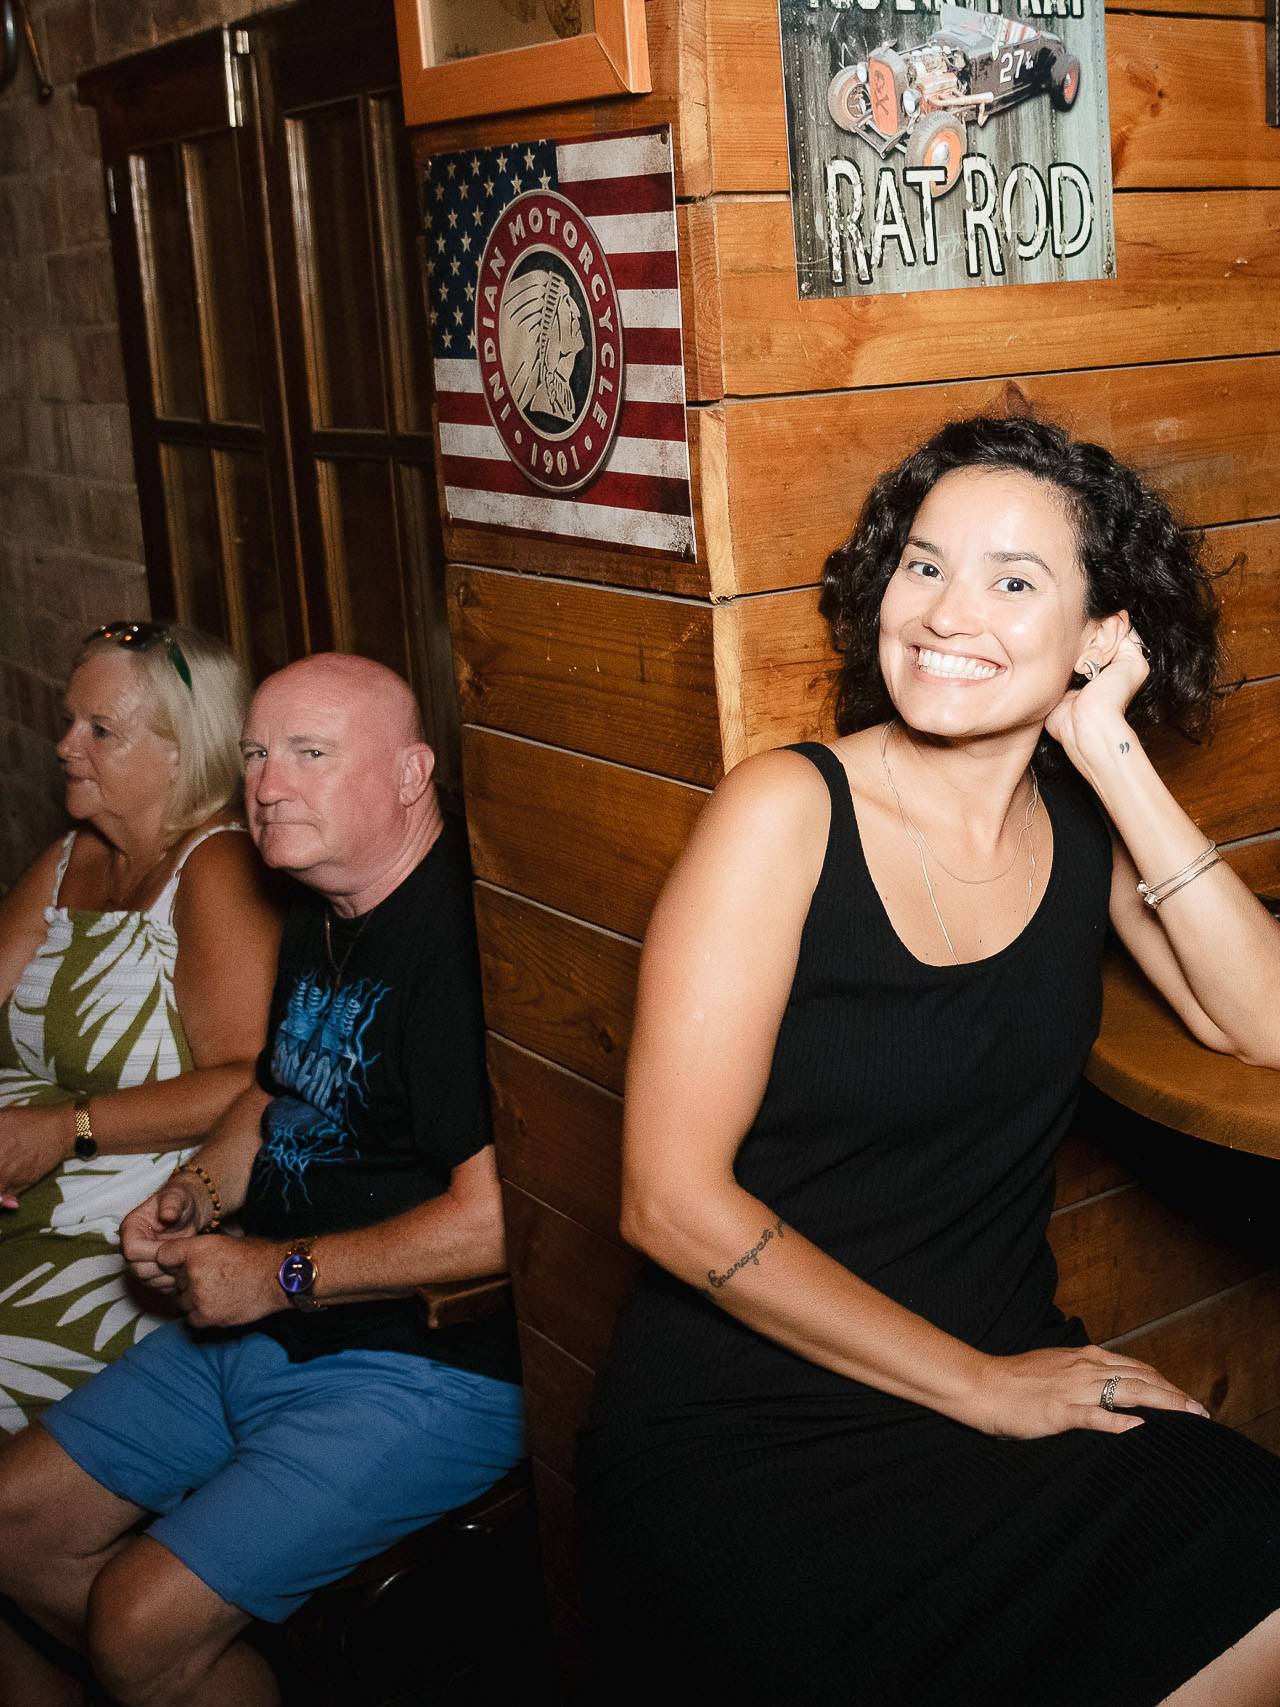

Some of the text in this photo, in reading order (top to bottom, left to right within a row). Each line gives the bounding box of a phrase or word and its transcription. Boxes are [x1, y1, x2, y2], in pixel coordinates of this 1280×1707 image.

[825, 152, 1095, 286] RAT ROD
[482, 207, 615, 429] INDIAN MOTORCYCLE
[531, 441, 580, 476] 1901
